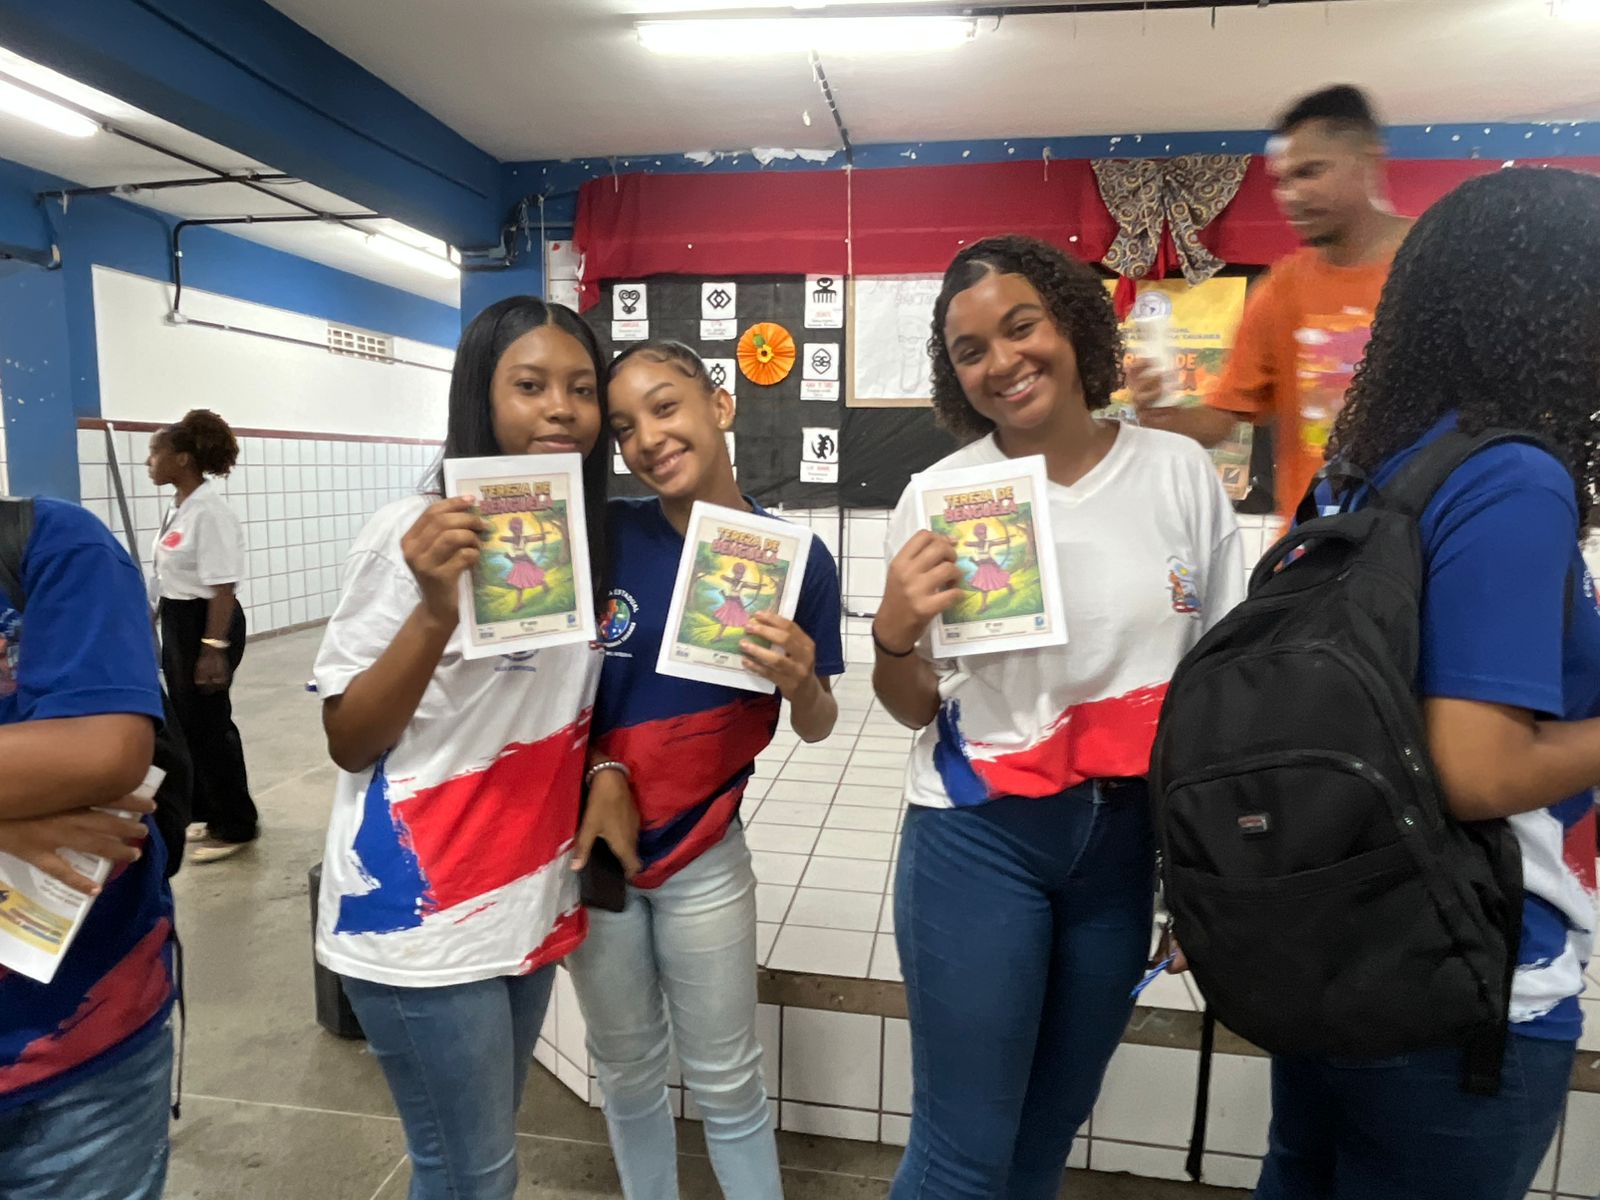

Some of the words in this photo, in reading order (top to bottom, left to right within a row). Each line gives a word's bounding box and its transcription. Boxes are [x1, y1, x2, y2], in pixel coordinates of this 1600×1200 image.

[479, 483, 531, 498] TEREZA
[535, 481, 551, 494] DE
[944, 491, 993, 507] TEREZA
[997, 487, 1013, 500] DE
[944, 499, 1017, 522] BENGUELA
[718, 528, 761, 546] TEREZA
[613, 588, 640, 613] ESTADUAL
